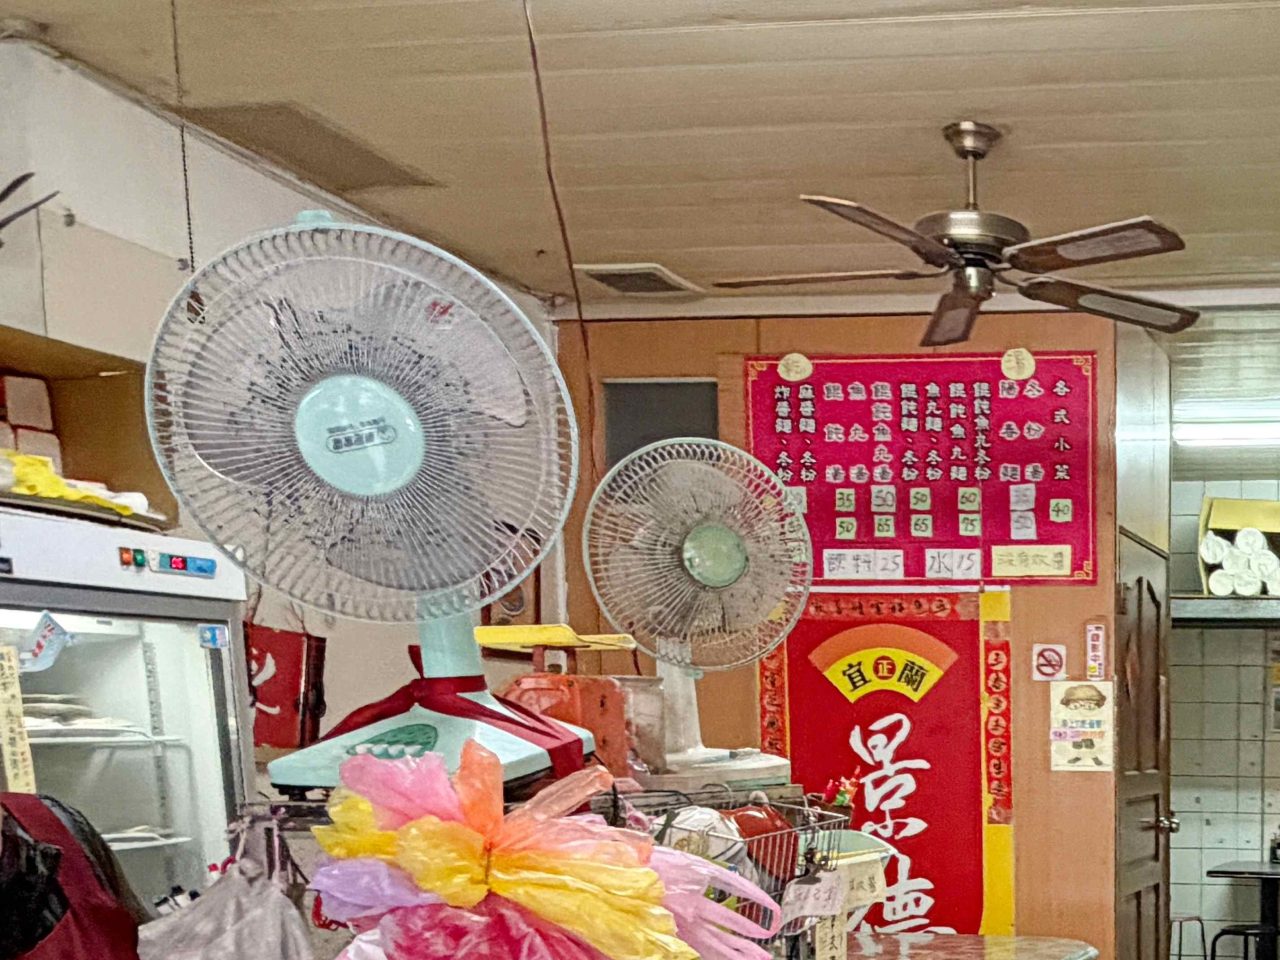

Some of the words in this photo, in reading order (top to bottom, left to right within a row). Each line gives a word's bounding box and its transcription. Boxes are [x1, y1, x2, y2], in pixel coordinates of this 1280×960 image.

[1052, 380, 1071, 480] 各式小菜
[913, 491, 927, 505] 50
[1052, 503, 1070, 516] 40
[838, 521, 854, 535] 50
[914, 518, 928, 531] 65
[880, 555, 901, 571] 25
[929, 551, 951, 573] 水
[958, 553, 976, 571] 15
